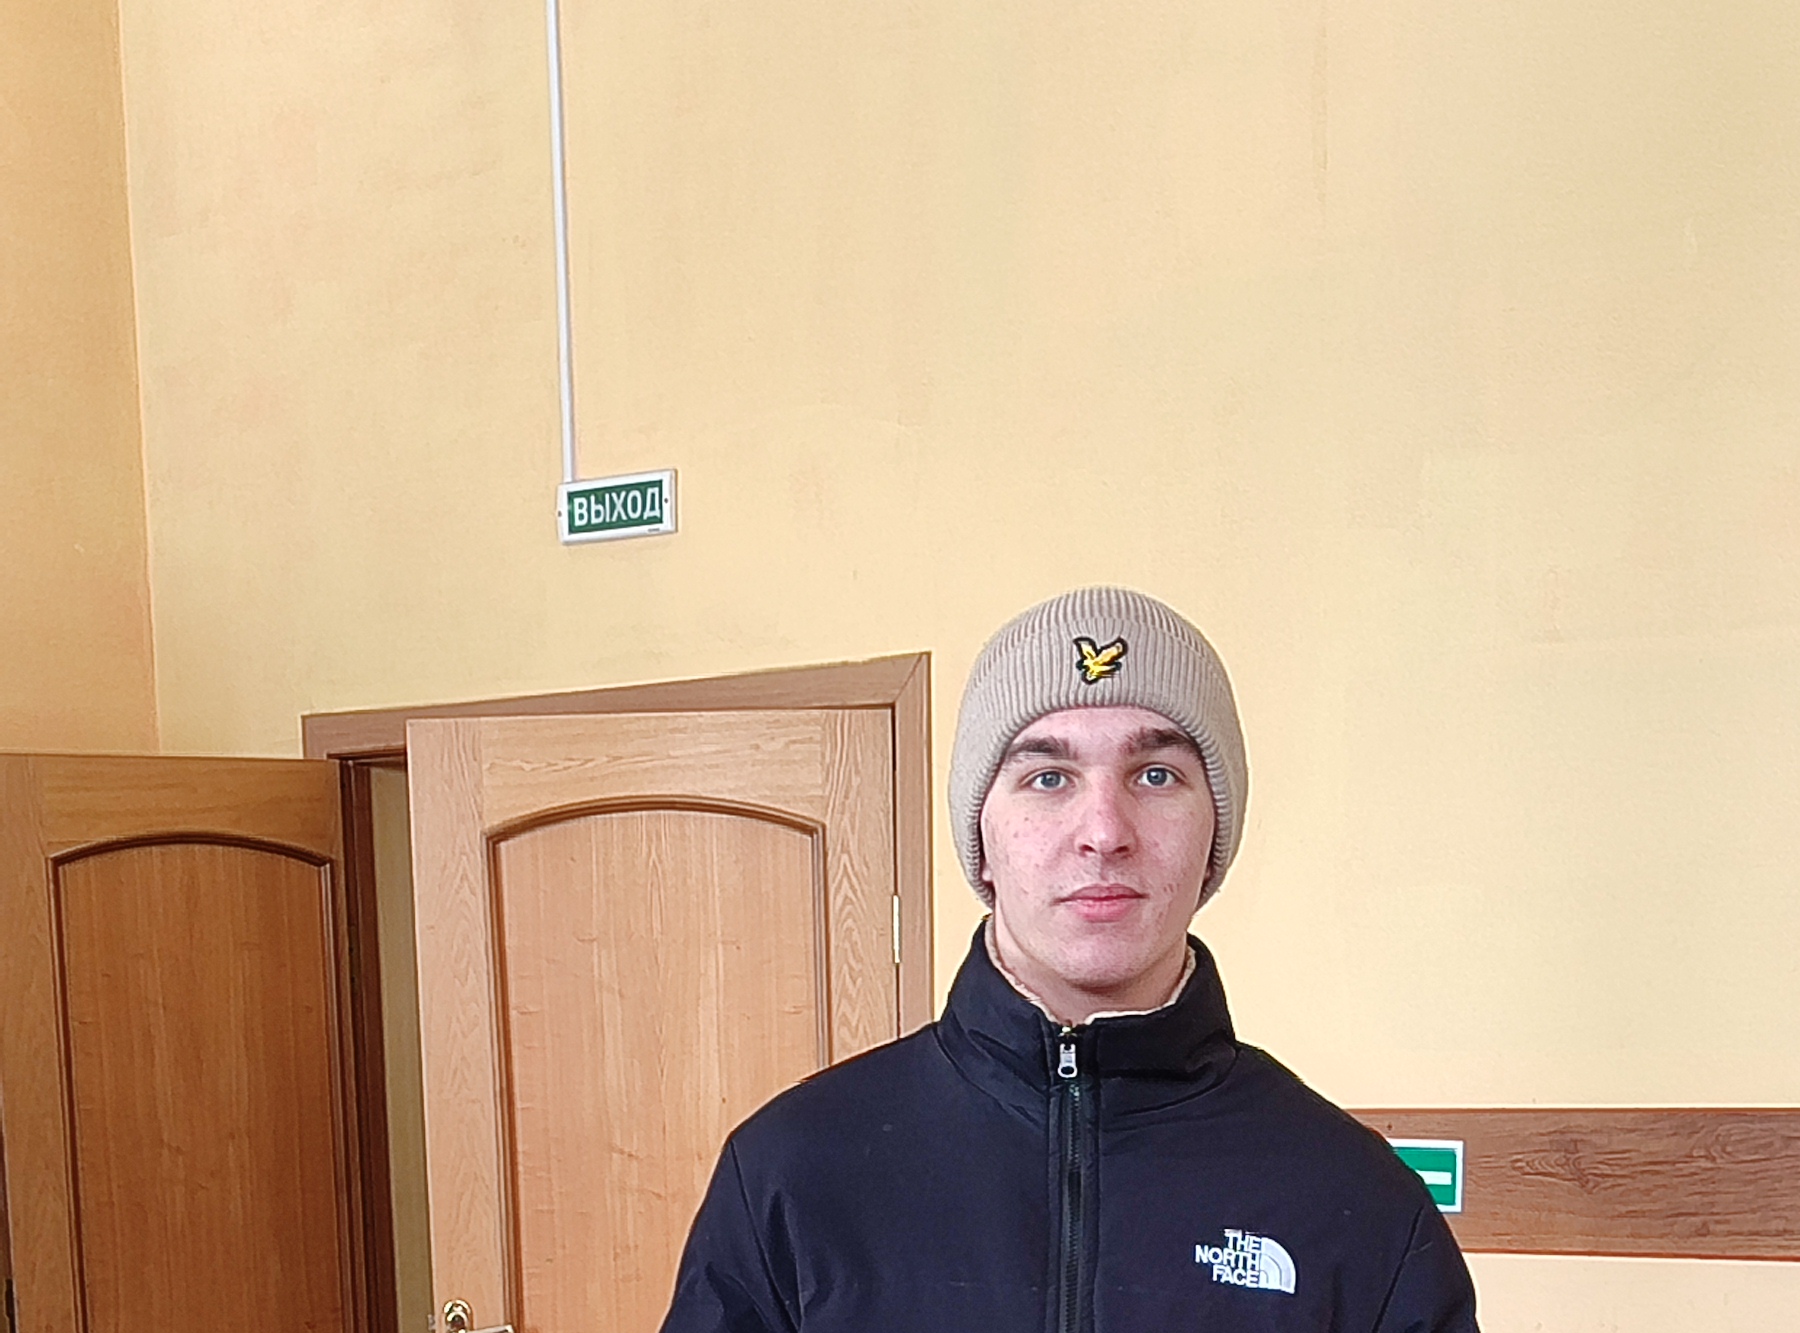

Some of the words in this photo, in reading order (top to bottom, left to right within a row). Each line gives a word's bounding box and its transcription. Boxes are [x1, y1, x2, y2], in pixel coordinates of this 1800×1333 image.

[573, 486, 661, 527] ВЫХОД
[1223, 1229, 1261, 1253] THE
[1195, 1244, 1261, 1271] NORTH
[1212, 1264, 1260, 1288] FACE
